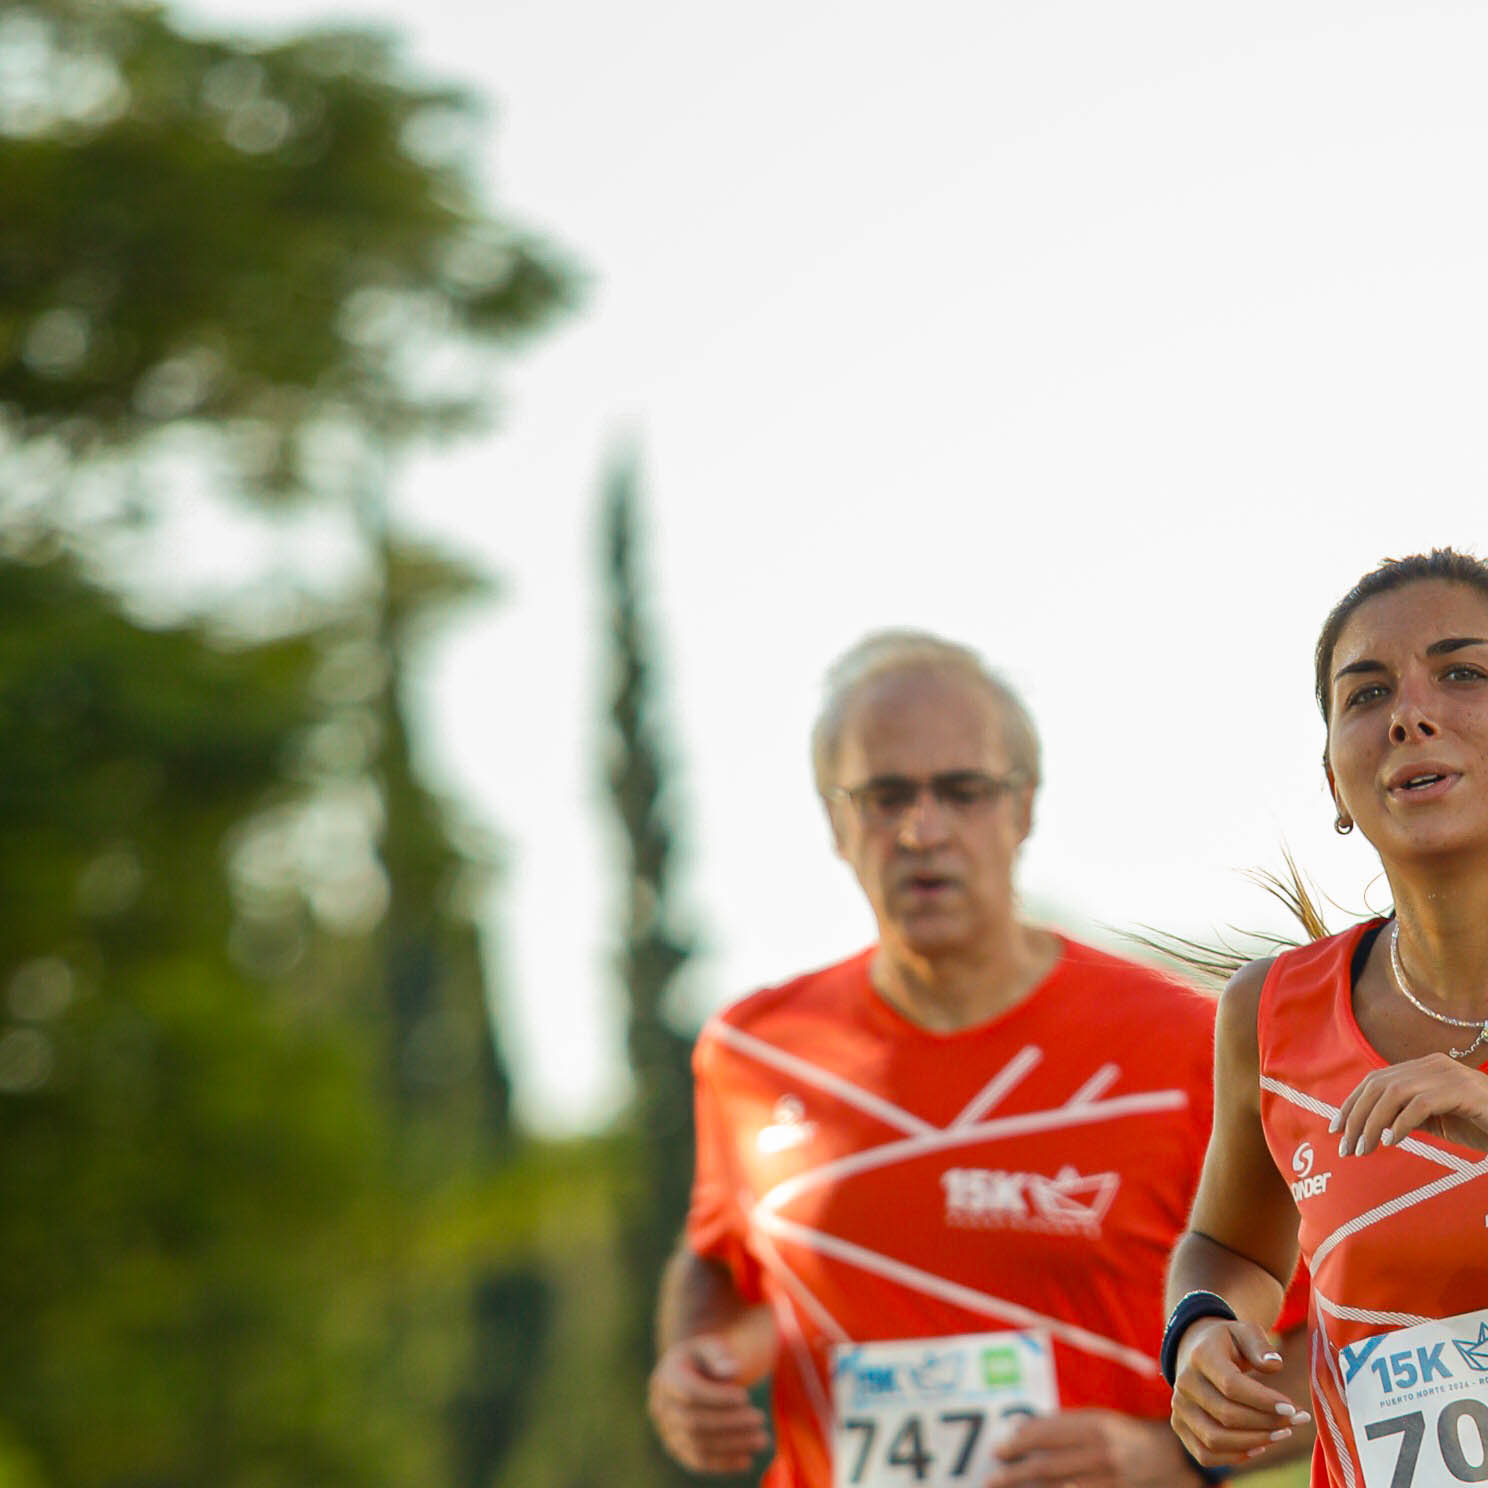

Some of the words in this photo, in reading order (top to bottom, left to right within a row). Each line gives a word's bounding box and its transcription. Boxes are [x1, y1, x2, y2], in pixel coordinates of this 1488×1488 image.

[1370, 1341, 1454, 1394] 15K
[1379, 1393, 1414, 1409] PUERTO
[1416, 1385, 1446, 1398] NORTE
[842, 1400, 1036, 1485] 747
